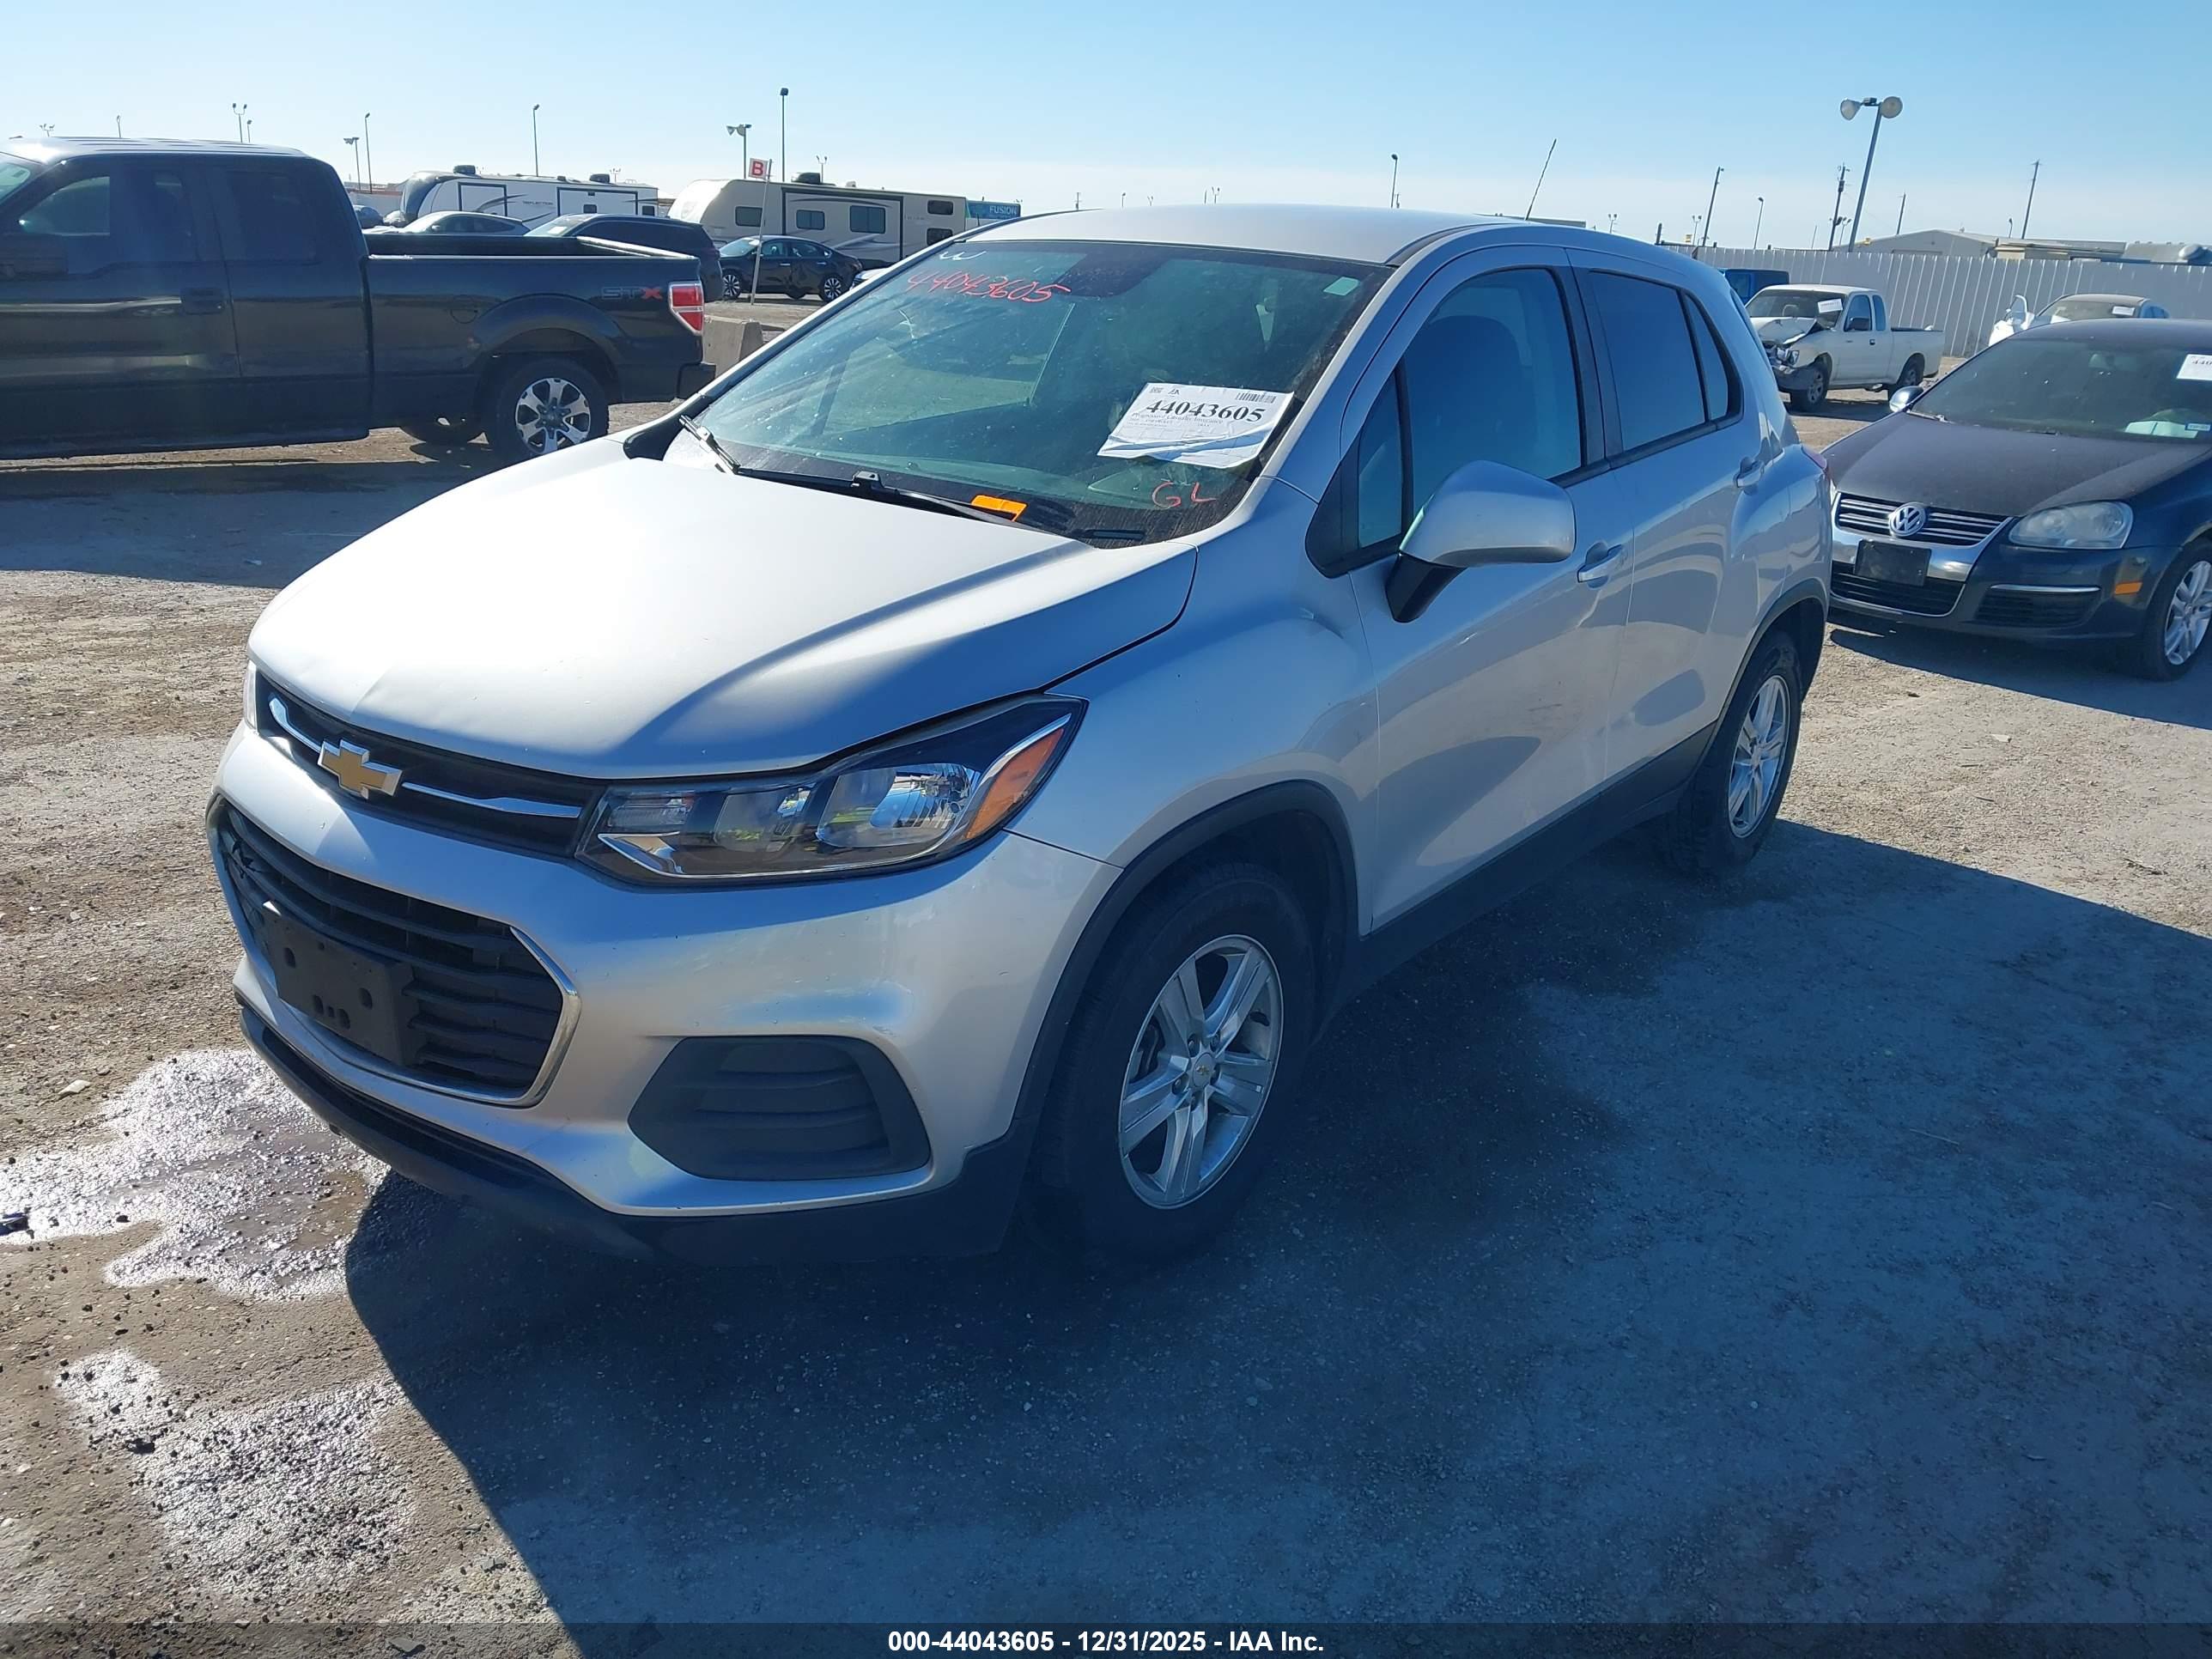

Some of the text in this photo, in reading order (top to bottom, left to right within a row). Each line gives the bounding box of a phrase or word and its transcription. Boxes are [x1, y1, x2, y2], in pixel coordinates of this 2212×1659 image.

[751, 161, 764, 176] B
[989, 205, 1018, 216] FUSION
[602, 286, 663, 300] STX
[905, 270, 1072, 302] 44043605
[1146, 399, 1266, 422] 44043605
